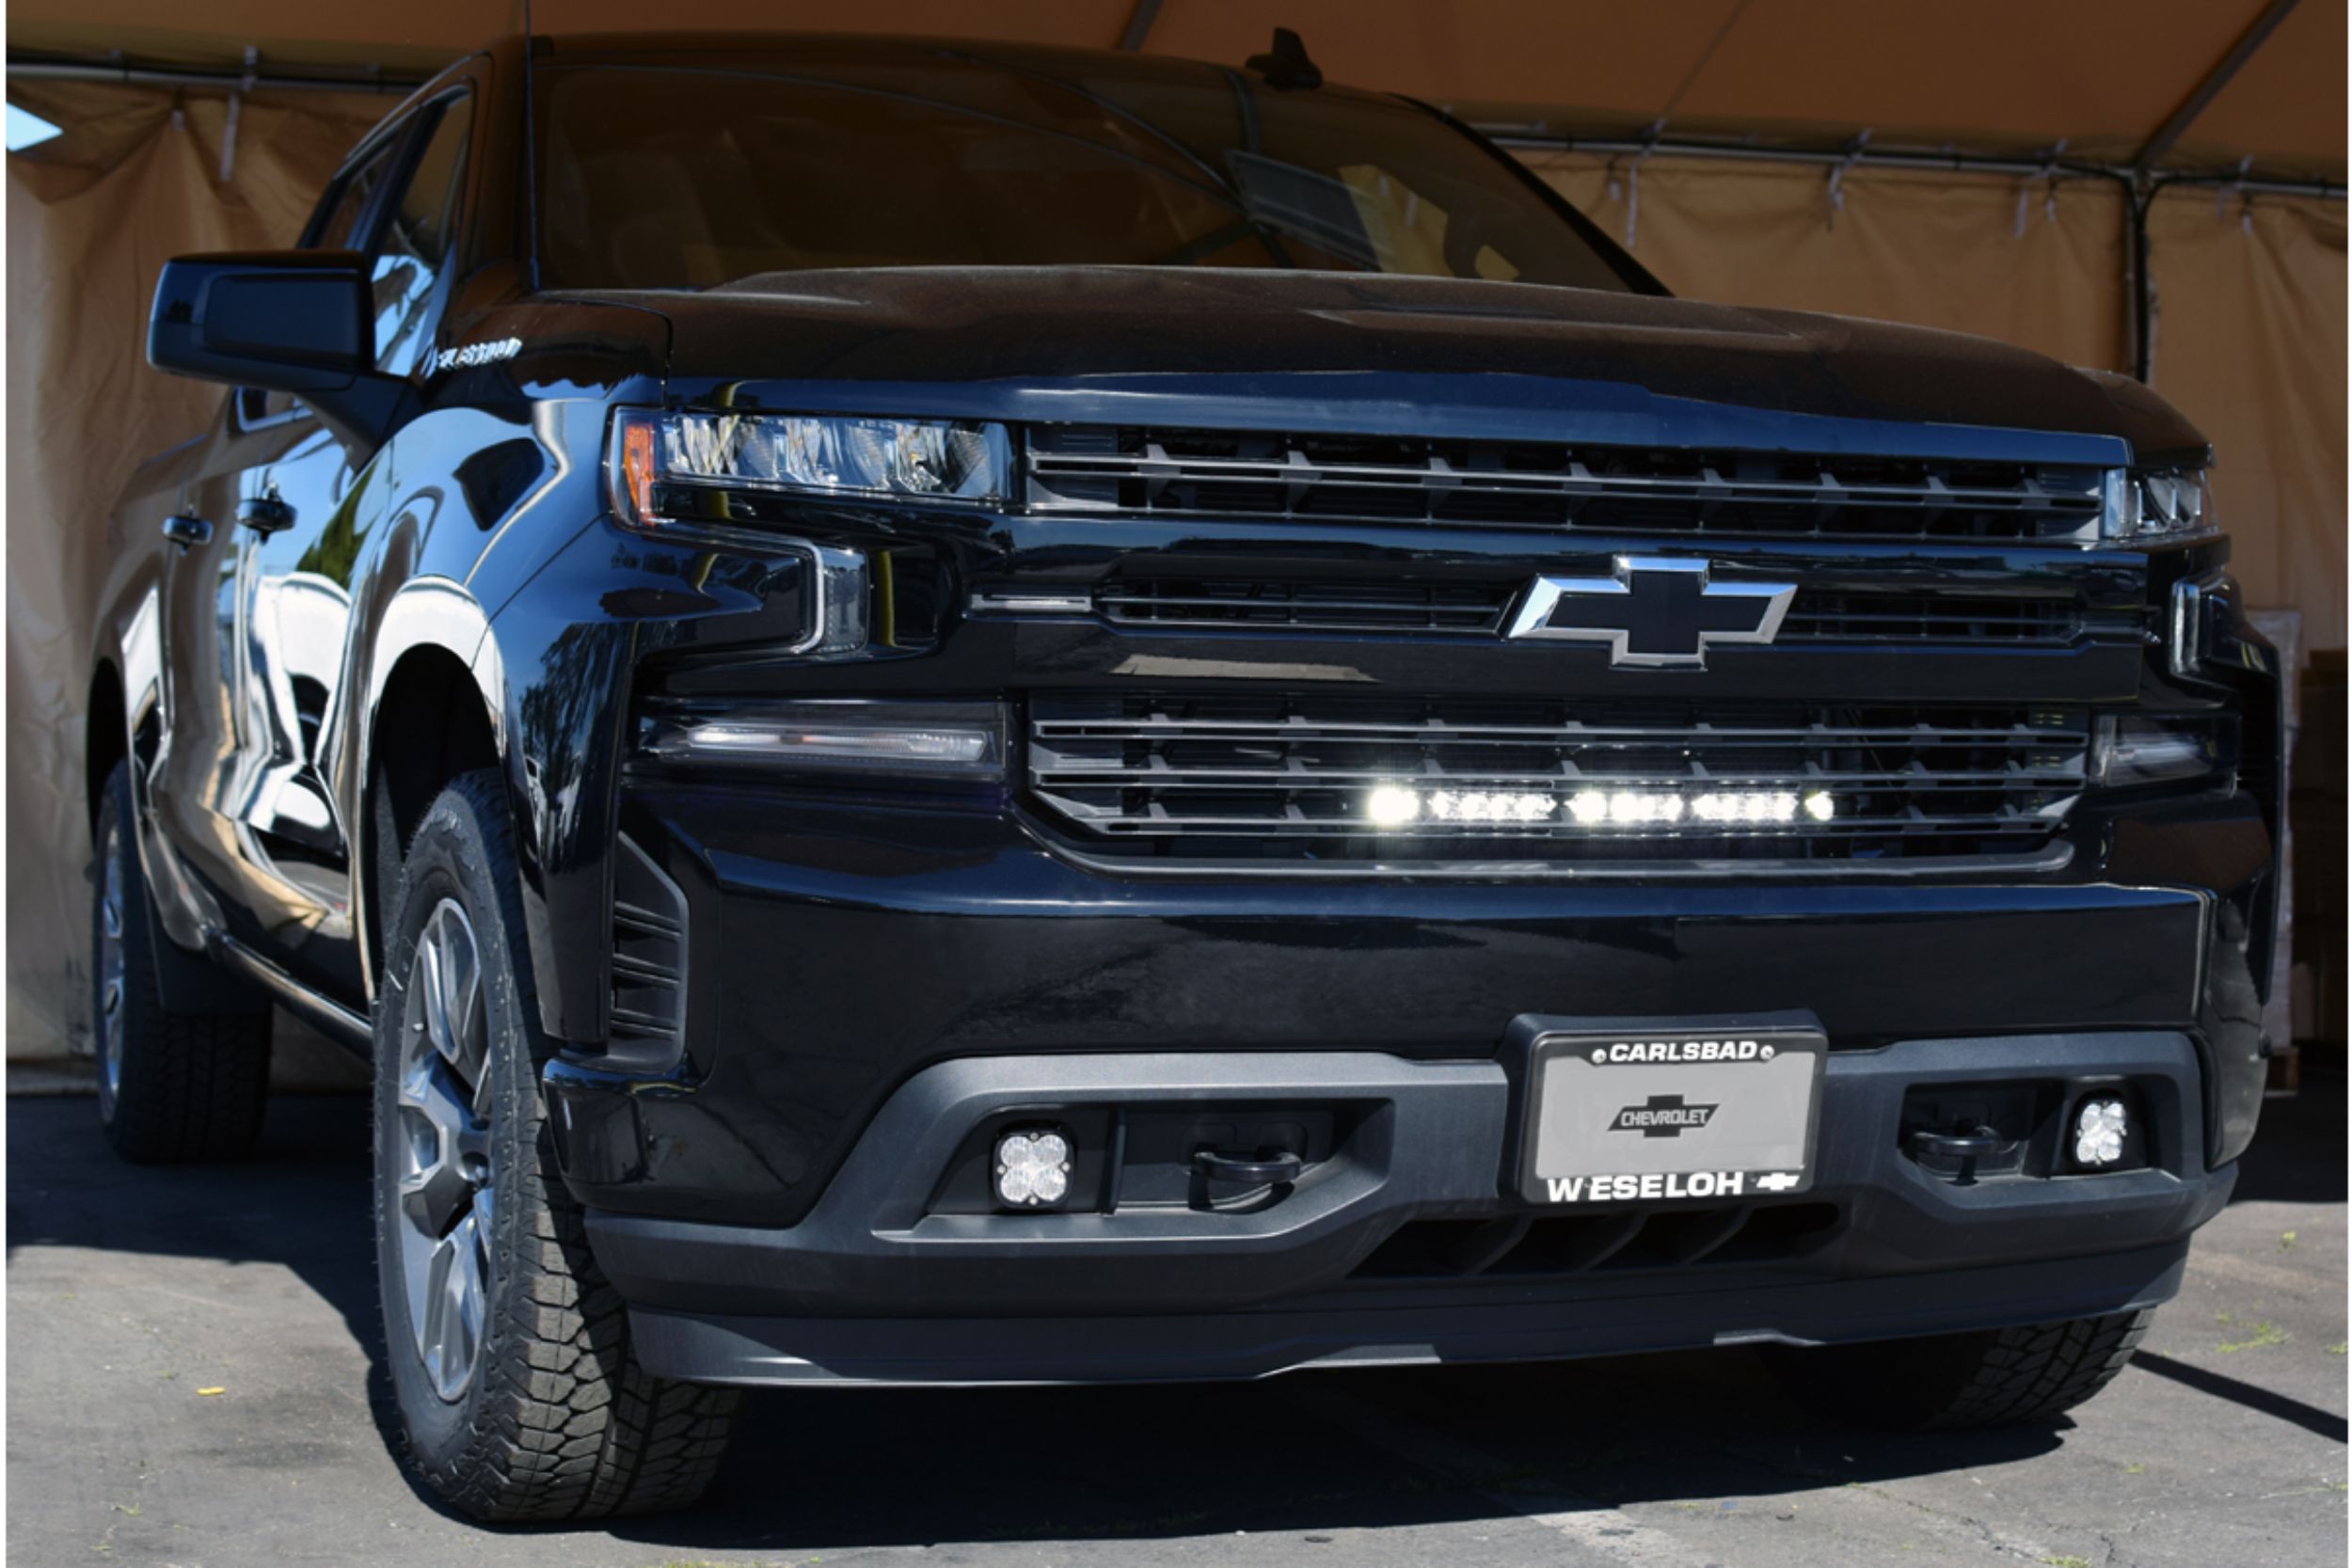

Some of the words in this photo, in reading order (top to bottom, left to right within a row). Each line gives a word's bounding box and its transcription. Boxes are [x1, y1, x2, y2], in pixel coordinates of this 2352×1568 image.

[1610, 1041, 1757, 1062] CARLSBAD
[1620, 1108, 1709, 1127] CHEVROLET
[1547, 1171, 1743, 1203] WESELOH
